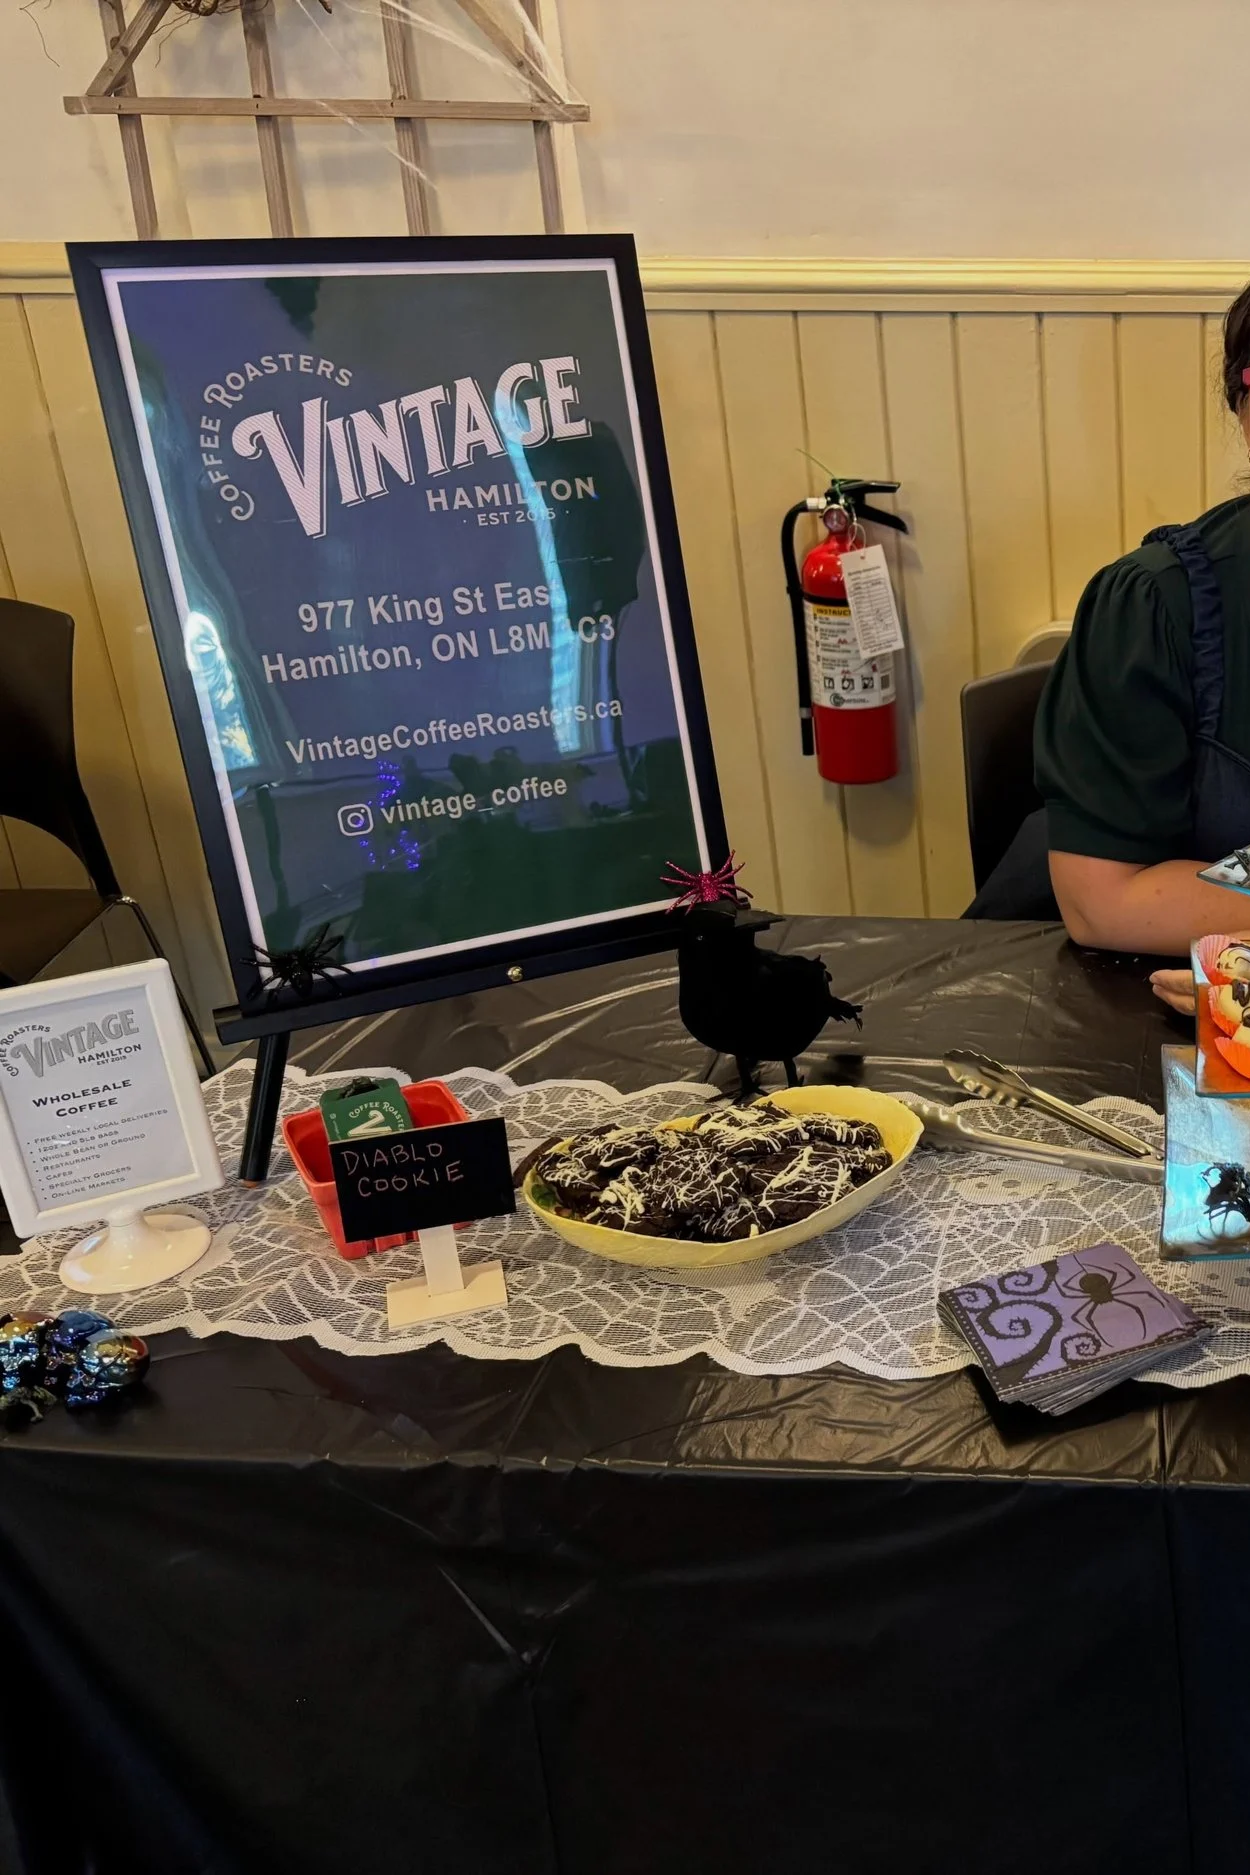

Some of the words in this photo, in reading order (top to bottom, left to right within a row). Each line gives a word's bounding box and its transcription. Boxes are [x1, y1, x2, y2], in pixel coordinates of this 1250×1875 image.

[203, 353, 353, 409] ROASTERS
[231, 355, 593, 539] VINTAGE
[200, 415, 255, 521] COFFEE
[477, 511, 510, 527] EST
[298, 599, 356, 634] 977
[367, 592, 442, 626] King
[454, 585, 487, 616] St
[494, 580, 561, 611] Eas
[262, 642, 422, 684] Hamilton,
[431, 629, 479, 663] ON
[489, 621, 550, 655] L8M
[286, 699, 623, 764] VintageCoffeeRoasters.ca
[380, 776, 568, 825] vintage_coffee
[0, 1024, 51, 1046] ROASTERS
[10, 1009, 140, 1078] VINTAGE
[77, 1043, 142, 1064] HAMILTON
[32, 1079, 132, 1108] WHOLESALE
[56, 1097, 118, 1117] COFFEE
[34, 1134, 57, 1144] FREE
[59, 1127, 91, 1138] WEEKLY
[93, 1120, 119, 1131] LOCAL
[121, 1109, 168, 1124] DELIVERIES
[348, 1101, 380, 1118] COFFEE
[382, 1101, 405, 1131] ROASTE
[40, 1151, 71, 1162] WHOLE
[73, 1145, 96, 1155] BEAN
[111, 1133, 146, 1145] GROUND
[98, 1130, 119, 1139] BAGS
[43, 1153, 101, 1172] RESTAURANTS
[340, 1142, 443, 1175] DIABLO
[48, 1174, 91, 1190] SPECIALTY
[93, 1165, 132, 1179] GROCERS
[88, 1176, 126, 1190] MARKETS
[358, 1160, 465, 1197] COOKIE
